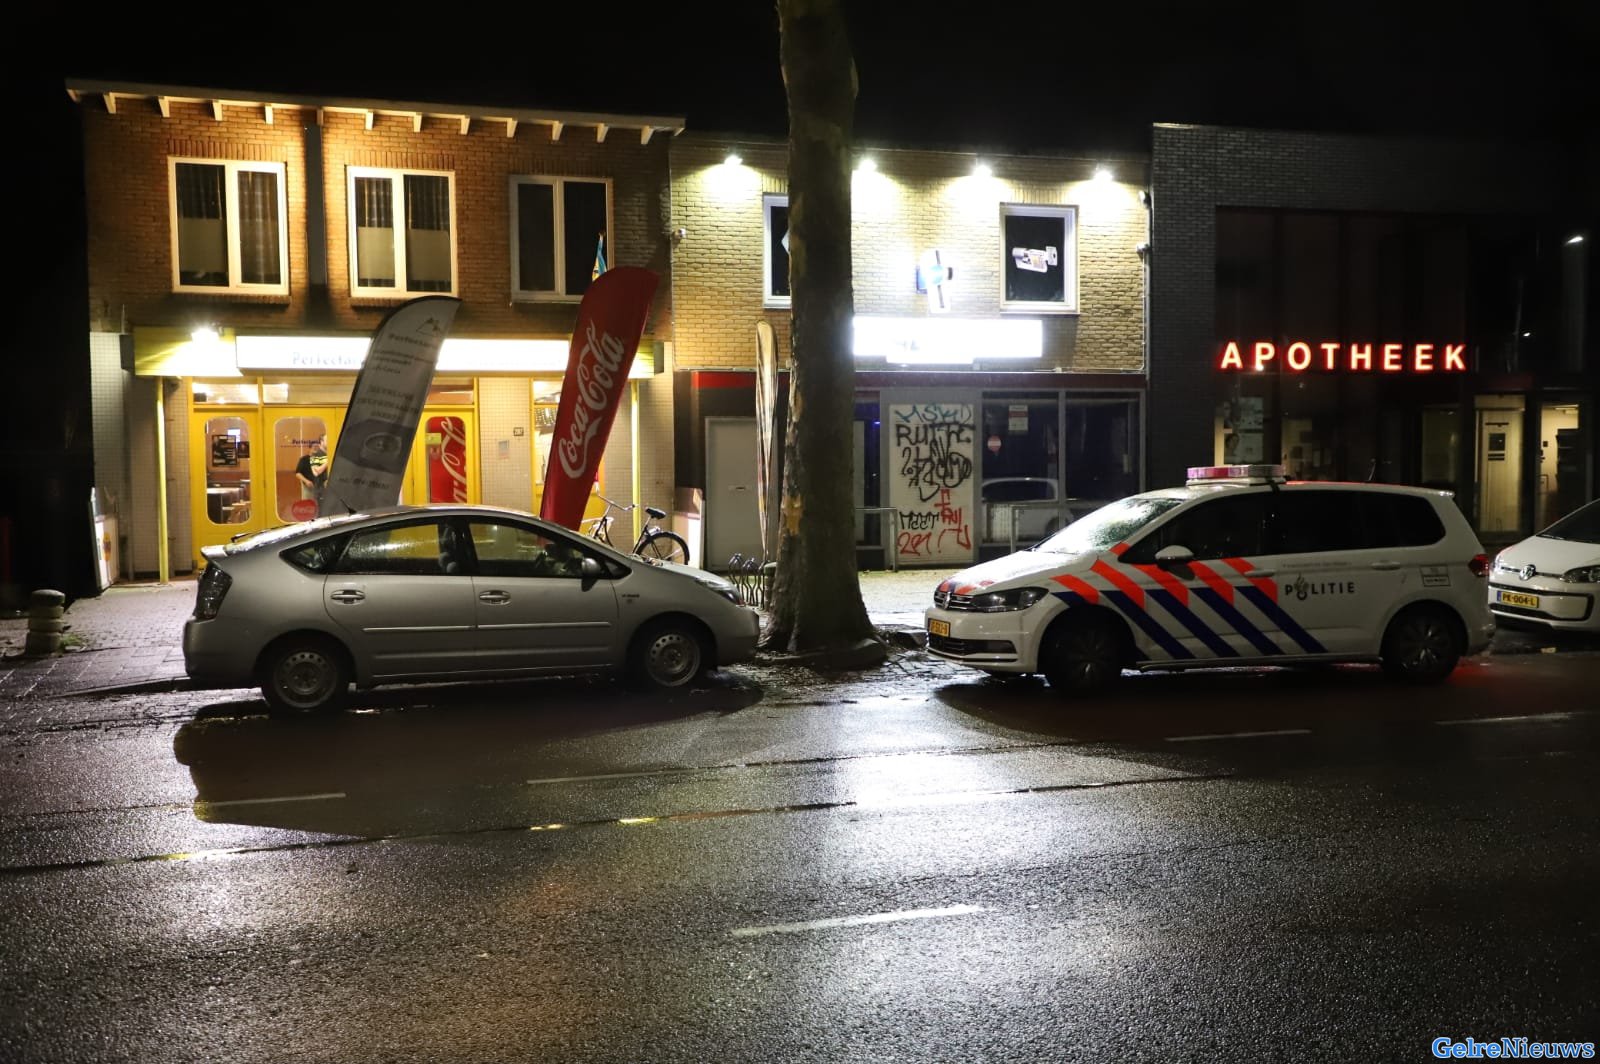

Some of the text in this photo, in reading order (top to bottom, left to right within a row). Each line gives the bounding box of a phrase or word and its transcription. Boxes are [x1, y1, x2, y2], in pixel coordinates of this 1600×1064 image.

[1221, 342, 1466, 370] APOTHEEK
[559, 318, 625, 479] Coca-Cola
[1285, 581, 1355, 600] POLITIE
